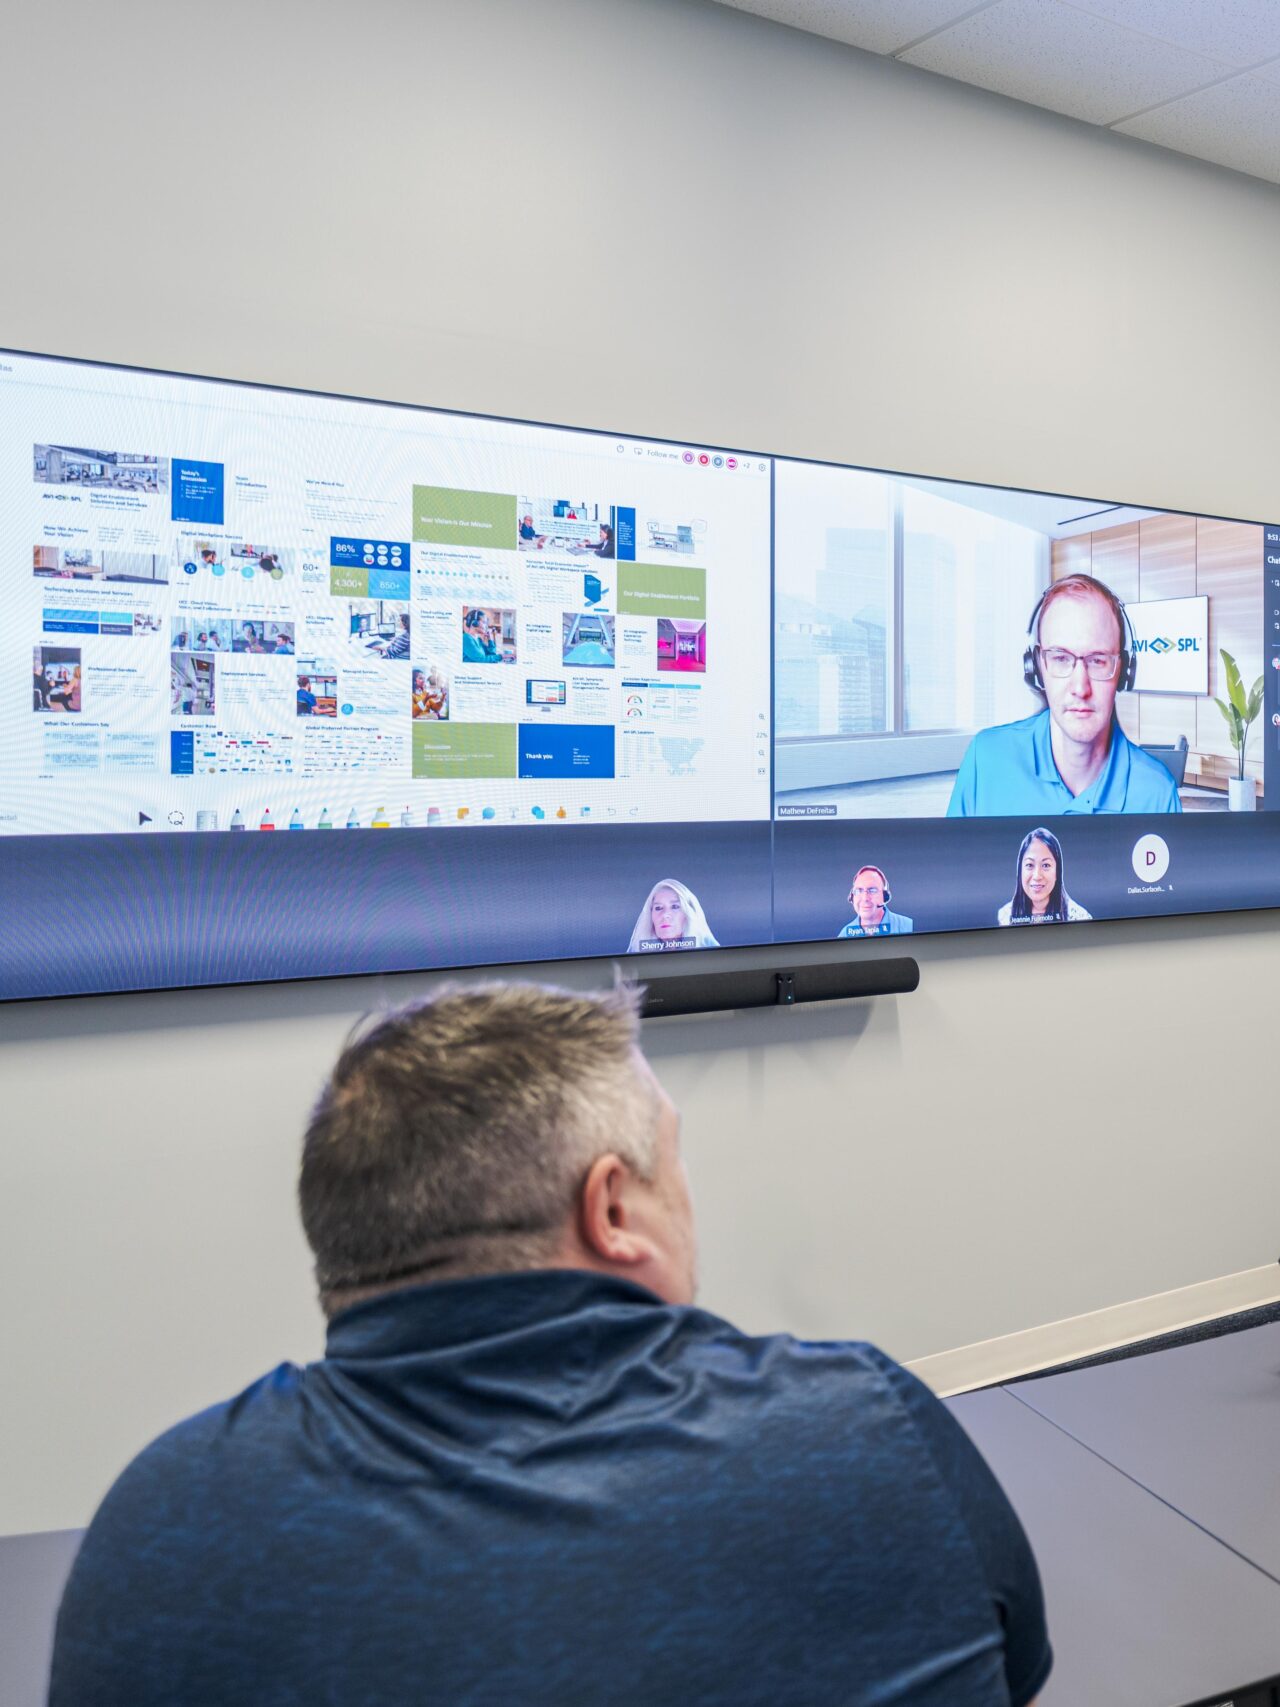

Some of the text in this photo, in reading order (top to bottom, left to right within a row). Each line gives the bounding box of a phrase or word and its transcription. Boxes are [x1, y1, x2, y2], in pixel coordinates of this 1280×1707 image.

[647, 449, 667, 459] Follow
[1267, 533, 1278, 541] 9:53
[335, 543, 356, 553] 86%
[302, 563, 319, 572] 60+
[1178, 638, 1199, 652] SPL
[780, 807, 836, 815] Mathew DeFreitas
[1146, 851, 1155, 865] D
[848, 927, 862, 936] Ryan
[641, 940, 694, 950] Sherry Johnson
